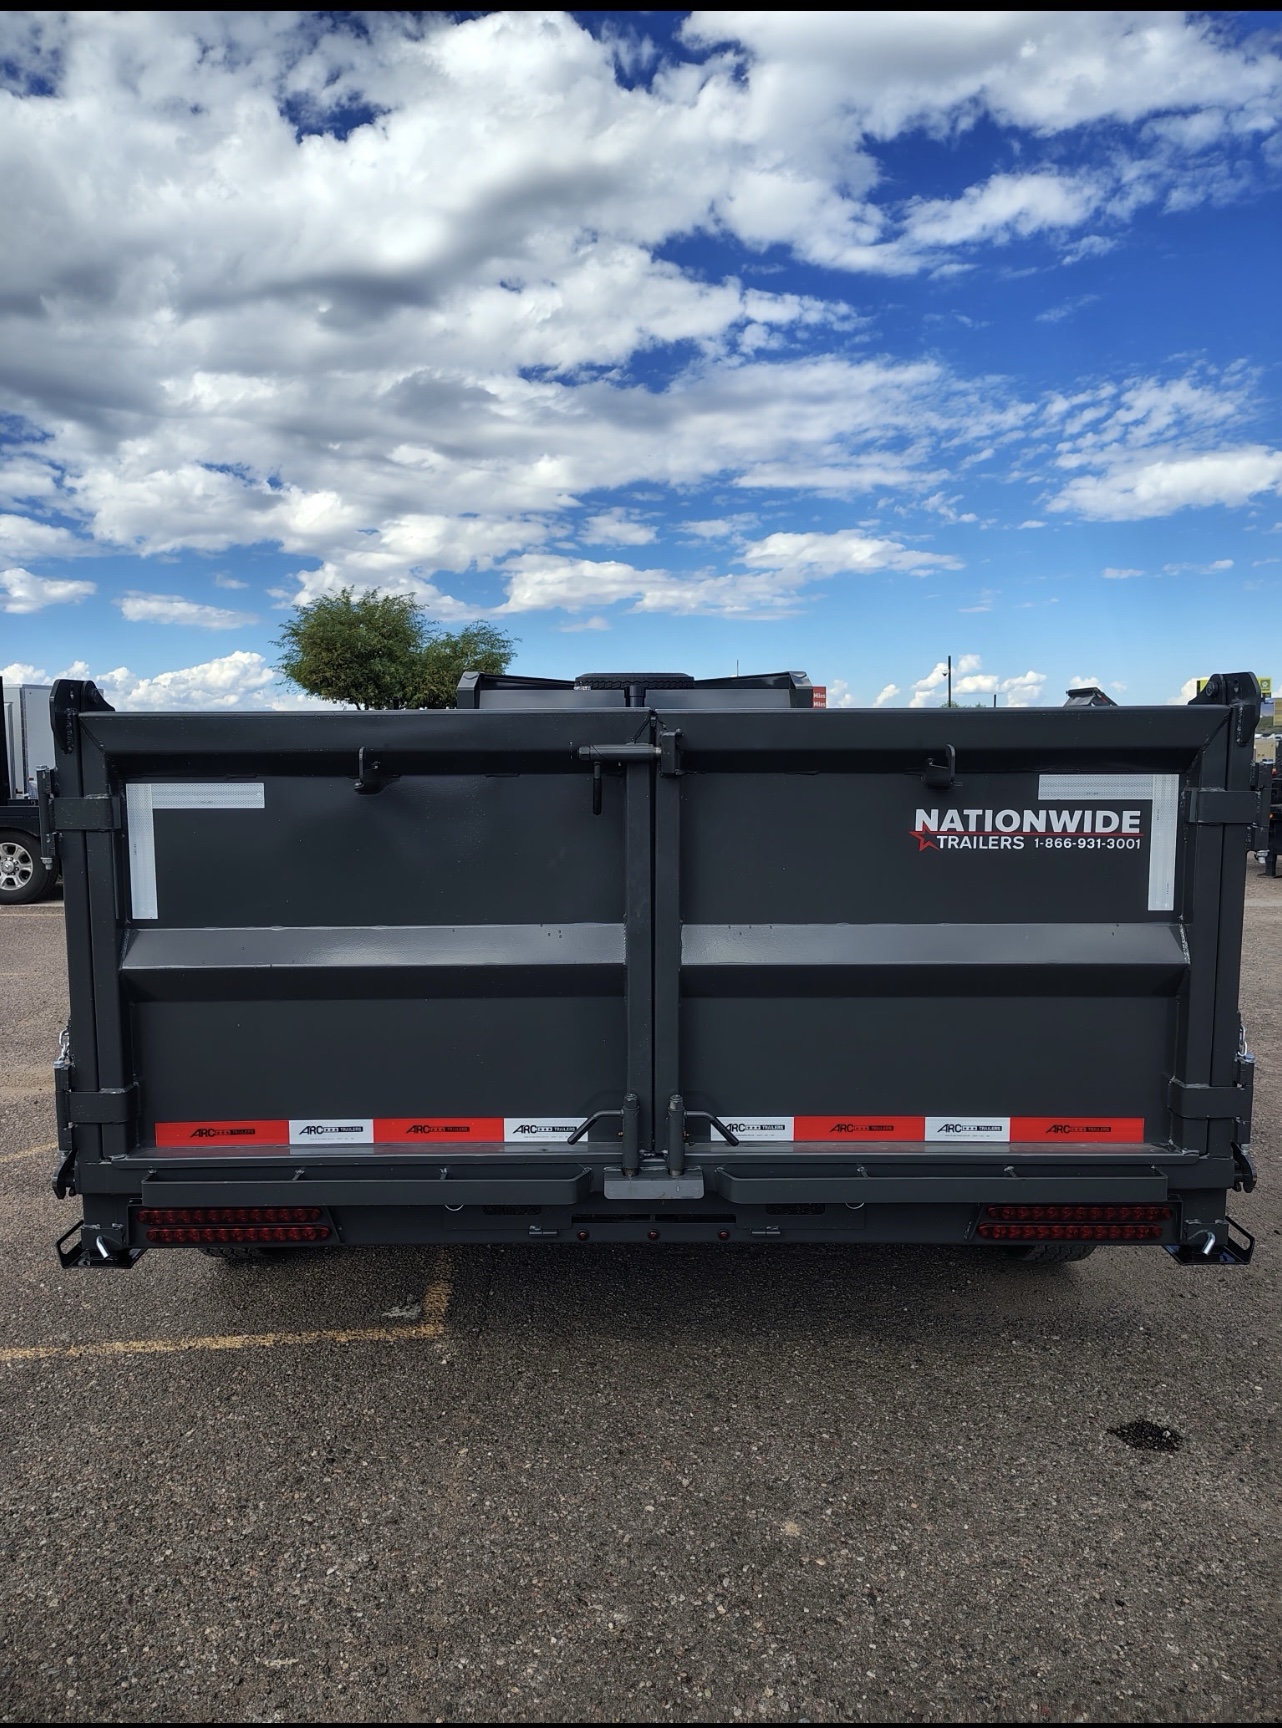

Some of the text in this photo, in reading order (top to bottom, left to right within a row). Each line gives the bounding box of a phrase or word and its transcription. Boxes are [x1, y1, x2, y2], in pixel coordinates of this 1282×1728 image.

[915, 809, 1141, 834] NATIONWIDE
[937, 835, 1141, 850] TRAILERS 1-866-931-3001
[190, 1128, 216, 1138] ARC
[299, 1125, 324, 1135] ARC
[405, 1124, 430, 1134] ARC
[512, 1124, 537, 1134] ARC
[829, 1123, 854, 1133] ARC
[937, 1123, 962, 1133] ARC
[1045, 1124, 1071, 1134] ARC
